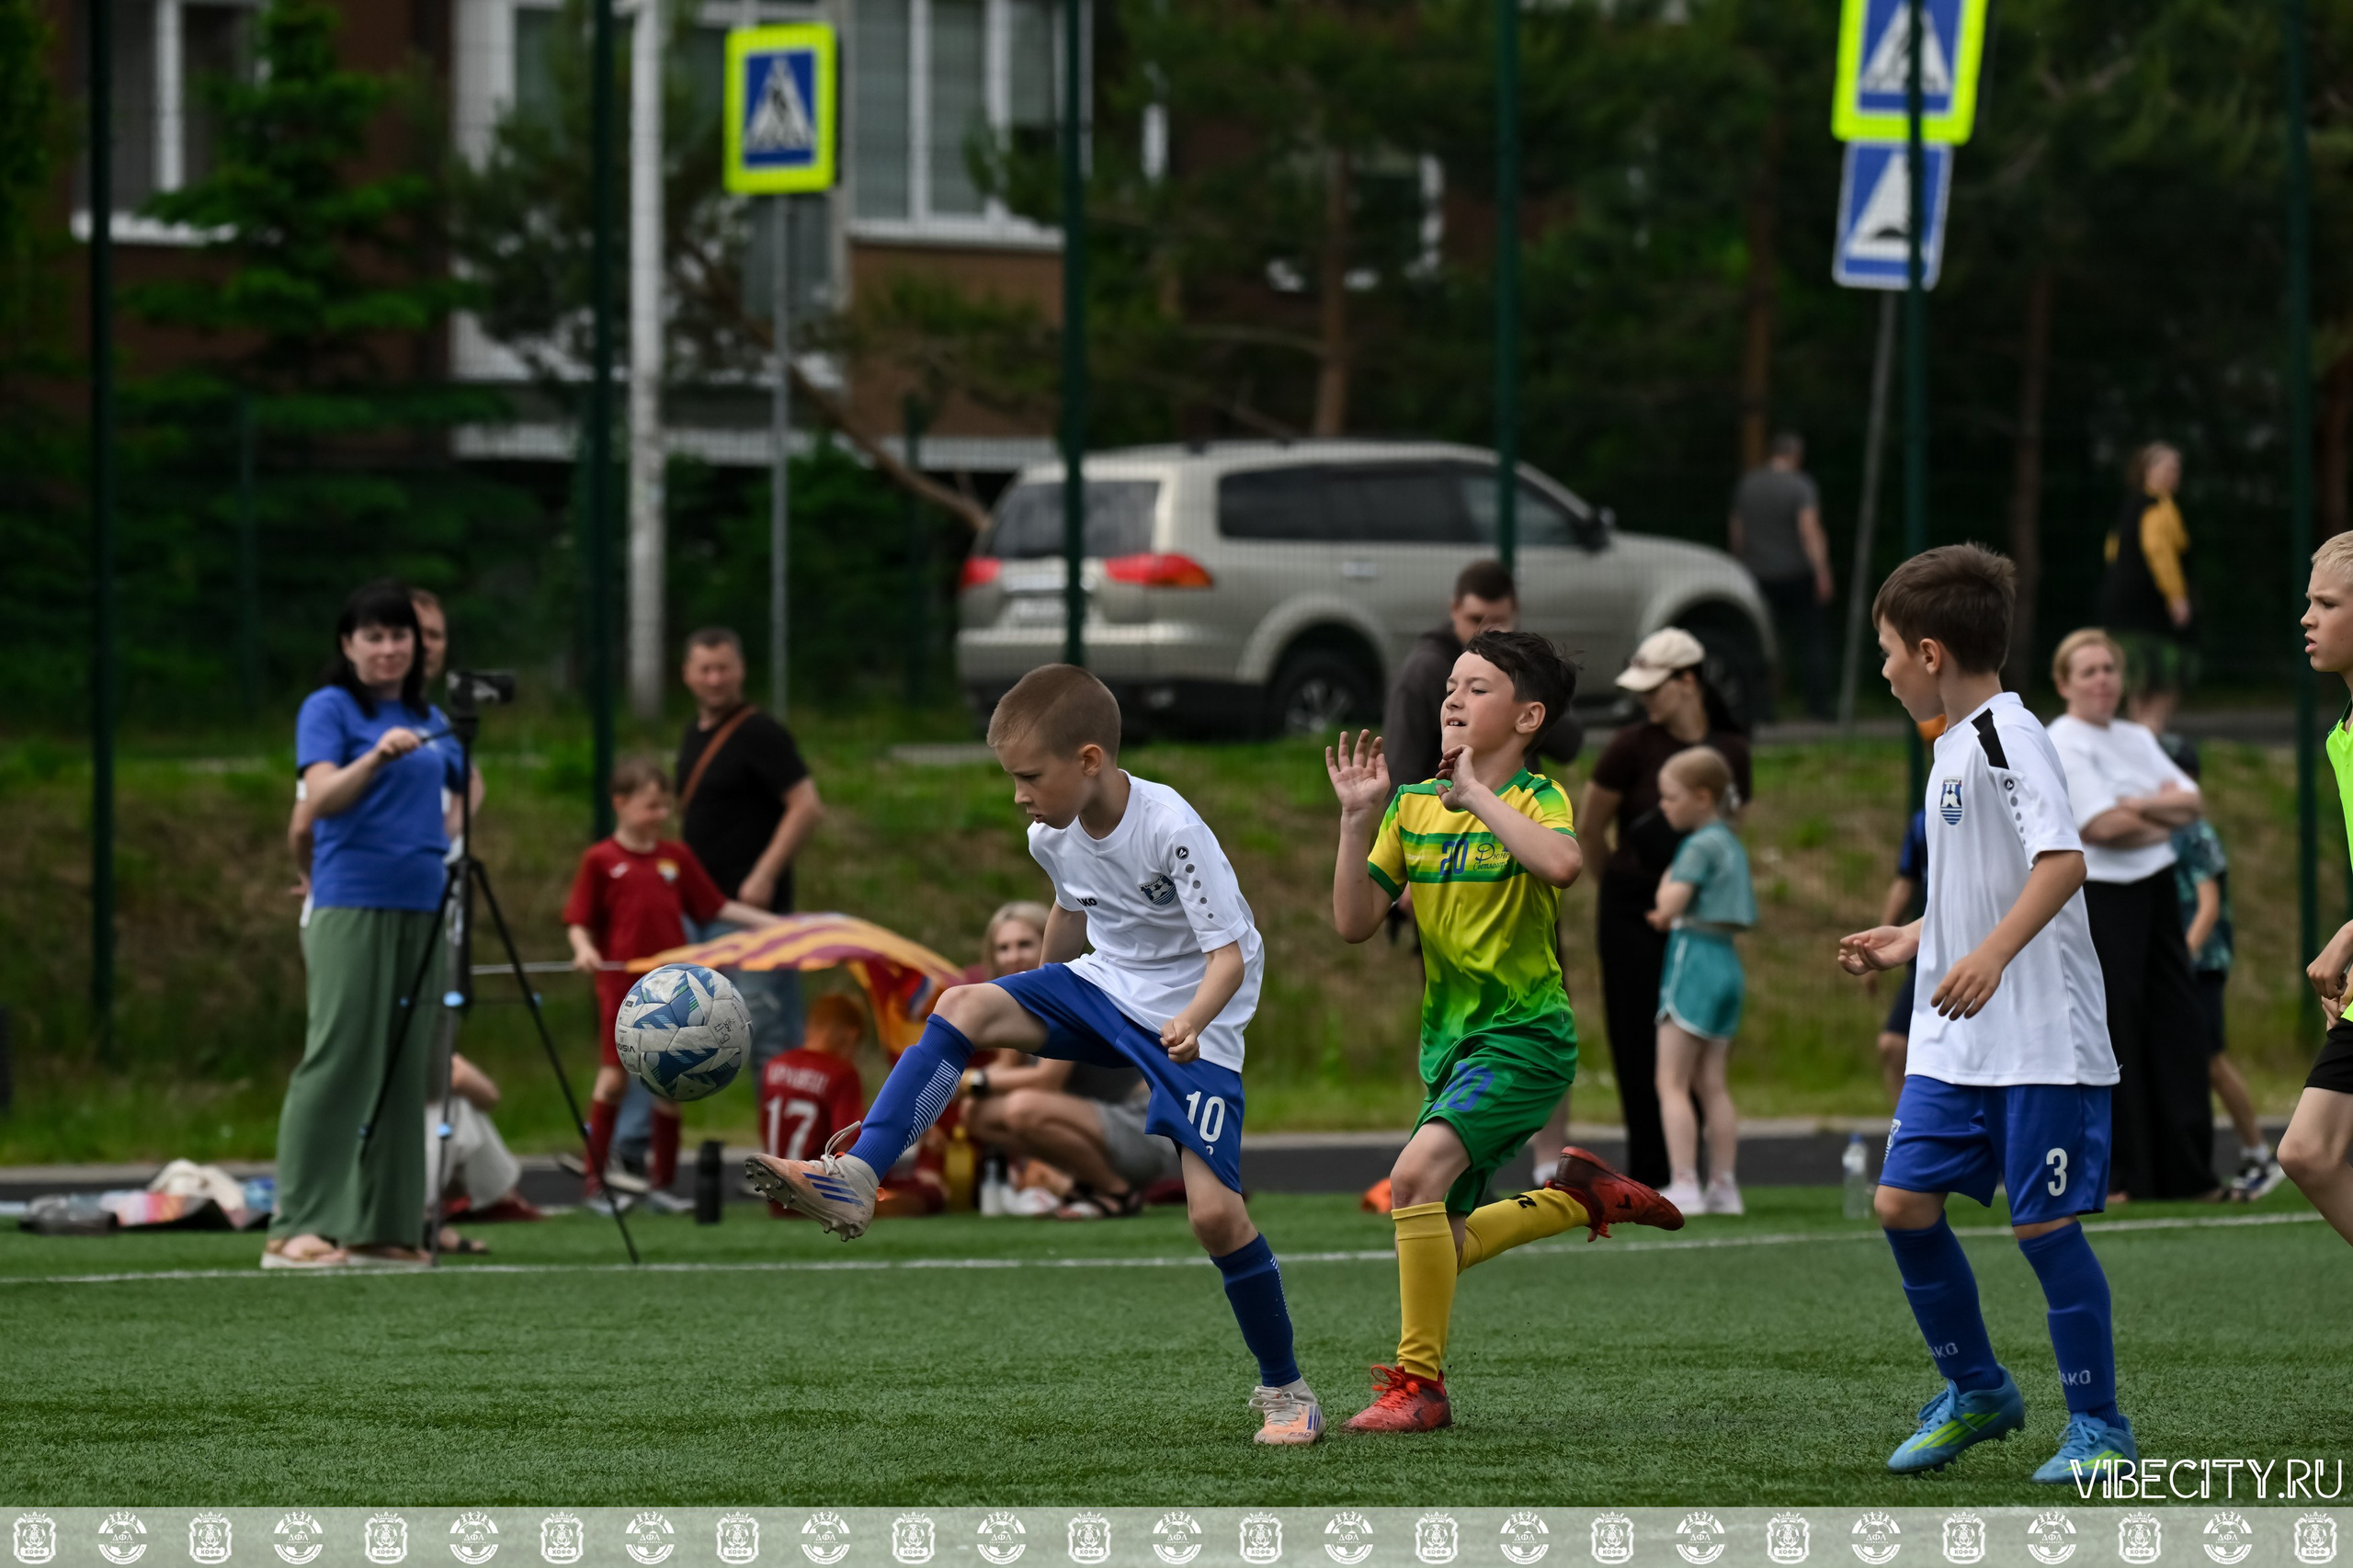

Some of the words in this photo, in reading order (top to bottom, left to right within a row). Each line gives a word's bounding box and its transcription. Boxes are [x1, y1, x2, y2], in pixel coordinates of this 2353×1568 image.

[1439, 838, 1470, 875] 20
[616, 1043, 636, 1054] VISIO
[766, 1096, 820, 1161] 17
[1186, 1090, 1226, 1142] 10
[2045, 1147, 2068, 1197] 3
